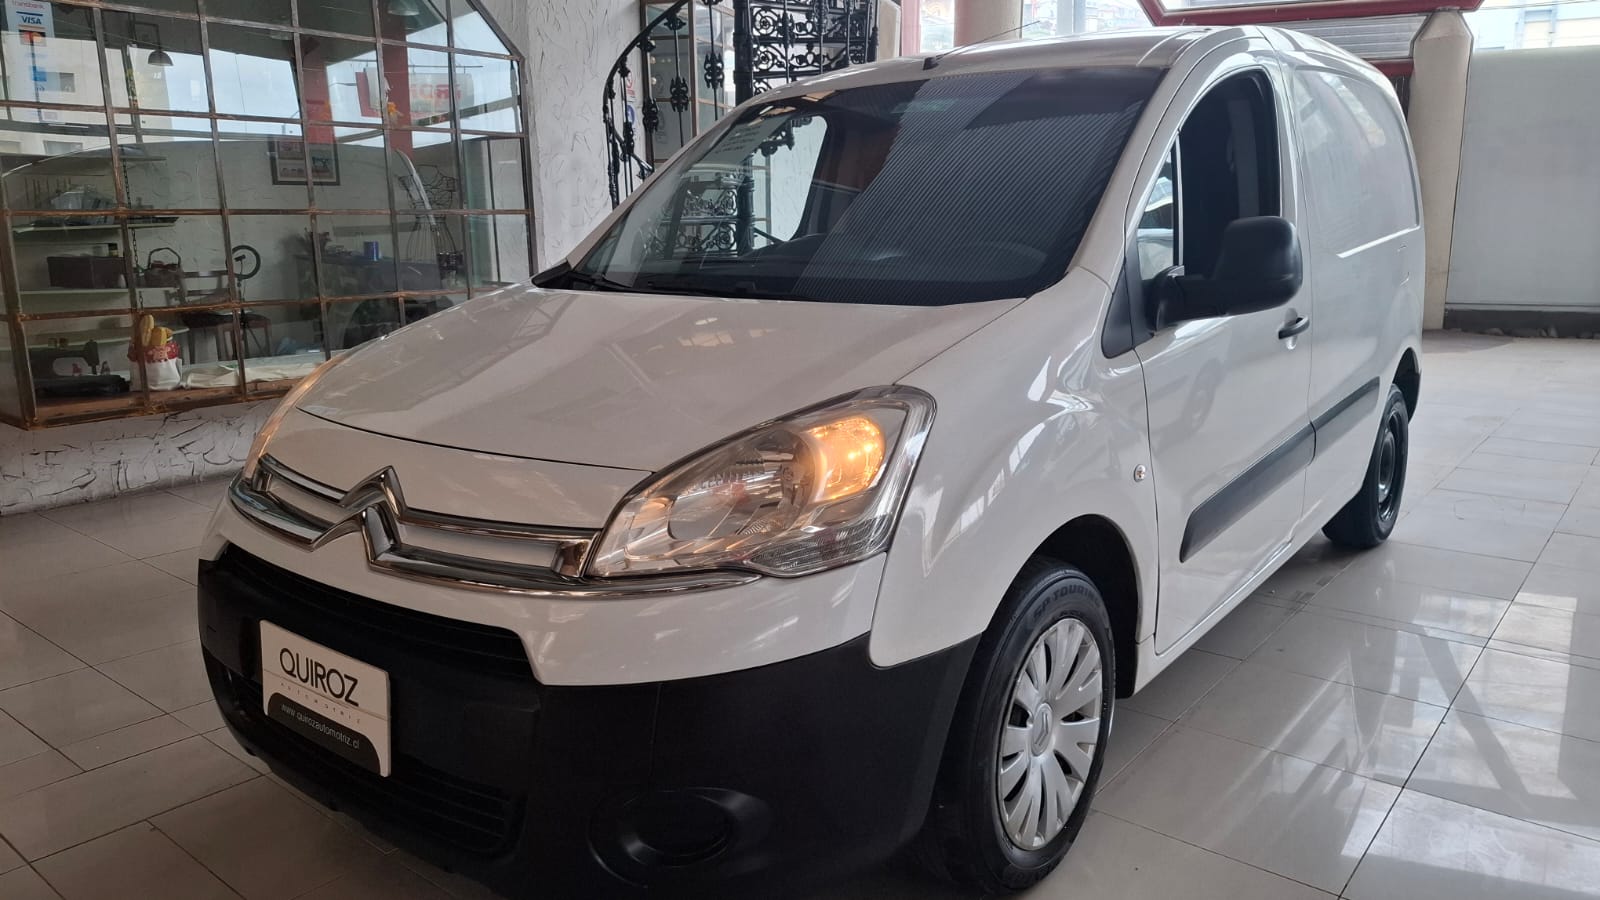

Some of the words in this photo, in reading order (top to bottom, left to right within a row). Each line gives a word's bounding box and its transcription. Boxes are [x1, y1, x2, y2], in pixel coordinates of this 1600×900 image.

[21, 16, 42, 25] VISA
[1053, 585, 1101, 609] TOURING
[279, 647, 359, 707] QUIROZ
